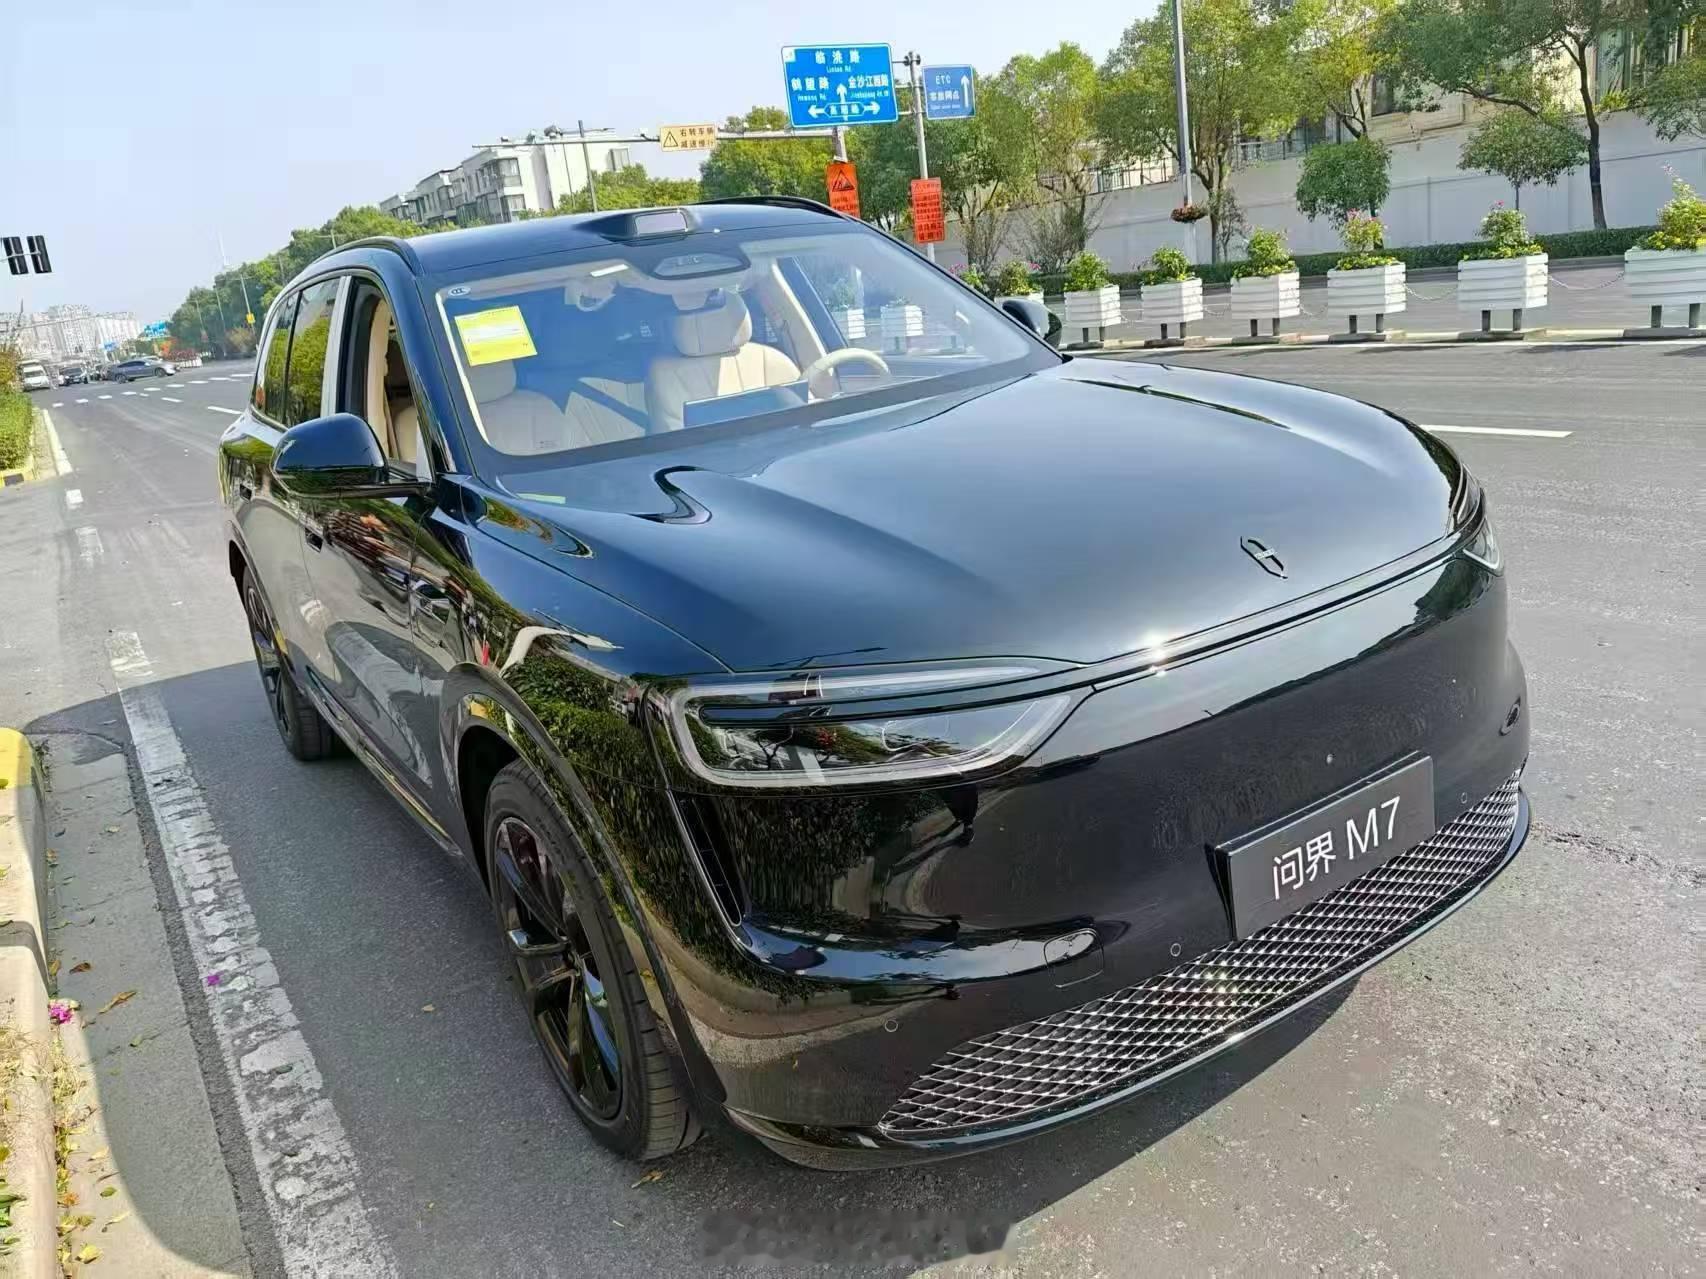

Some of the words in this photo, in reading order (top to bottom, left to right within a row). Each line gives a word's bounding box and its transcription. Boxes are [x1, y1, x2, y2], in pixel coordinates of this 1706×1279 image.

[848, 73, 889, 89] 金沙江西路
[936, 75, 951, 85] ETC
[680, 127, 714, 137] 右转车辆
[681, 139, 714, 148] 减速慢行
[1272, 830, 1337, 900] 问界
[1346, 795, 1402, 860] M7
